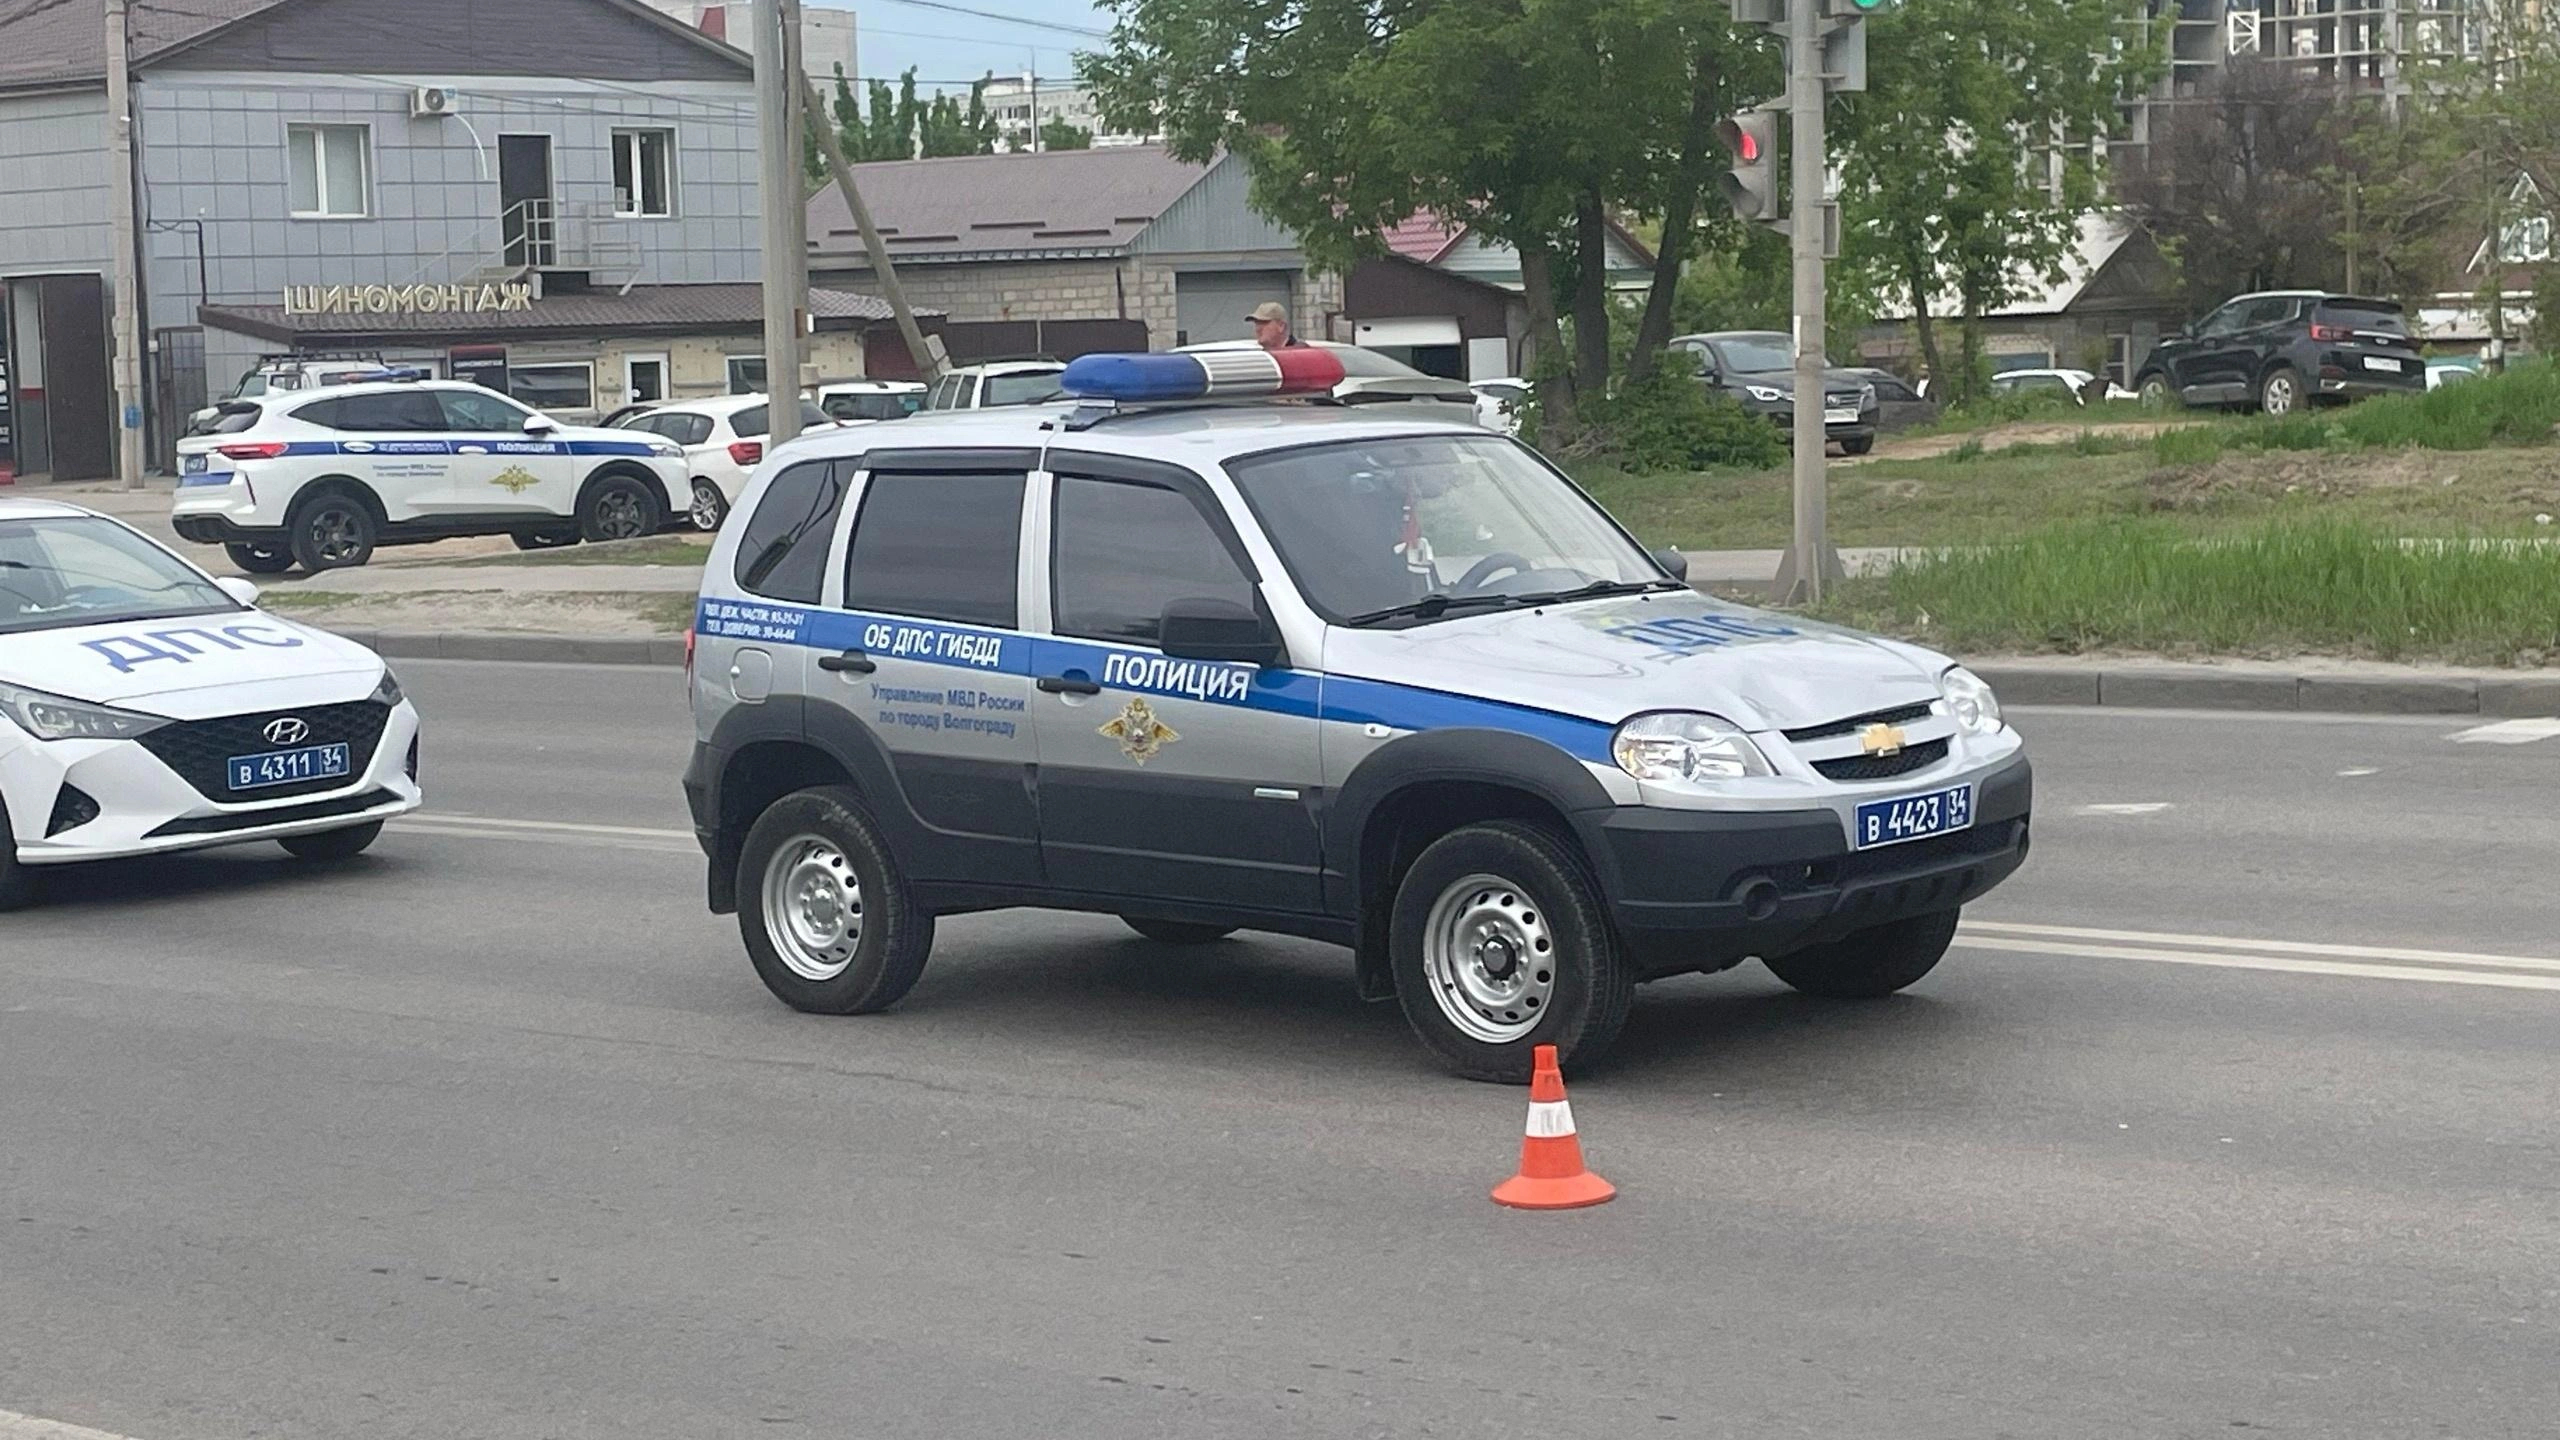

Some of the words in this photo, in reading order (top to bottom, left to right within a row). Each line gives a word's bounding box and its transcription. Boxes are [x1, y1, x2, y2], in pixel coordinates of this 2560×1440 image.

[284, 284, 532, 315] ШИНОМОНТАЖ
[496, 442, 555, 453] ПОЛИЦИЯ
[78, 626, 304, 673] ДПС
[864, 623, 892, 649] ОБ
[892, 628, 934, 656] ДПС
[937, 633, 1002, 667] ГИБДД
[1104, 653, 1250, 701] ПОЛИЦИЯ
[871, 683, 944, 705] Управление
[947, 690, 976, 709] МВД
[979, 692, 1025, 712] России
[879, 711, 896, 723] по
[899, 712, 941, 732] городу
[944, 713, 1016, 739] Волгограду
[260, 752, 310, 781] 4311
[322, 747, 342, 766] 34
[1888, 797, 1940, 837] 4423
[1949, 788, 1967, 815] 34
